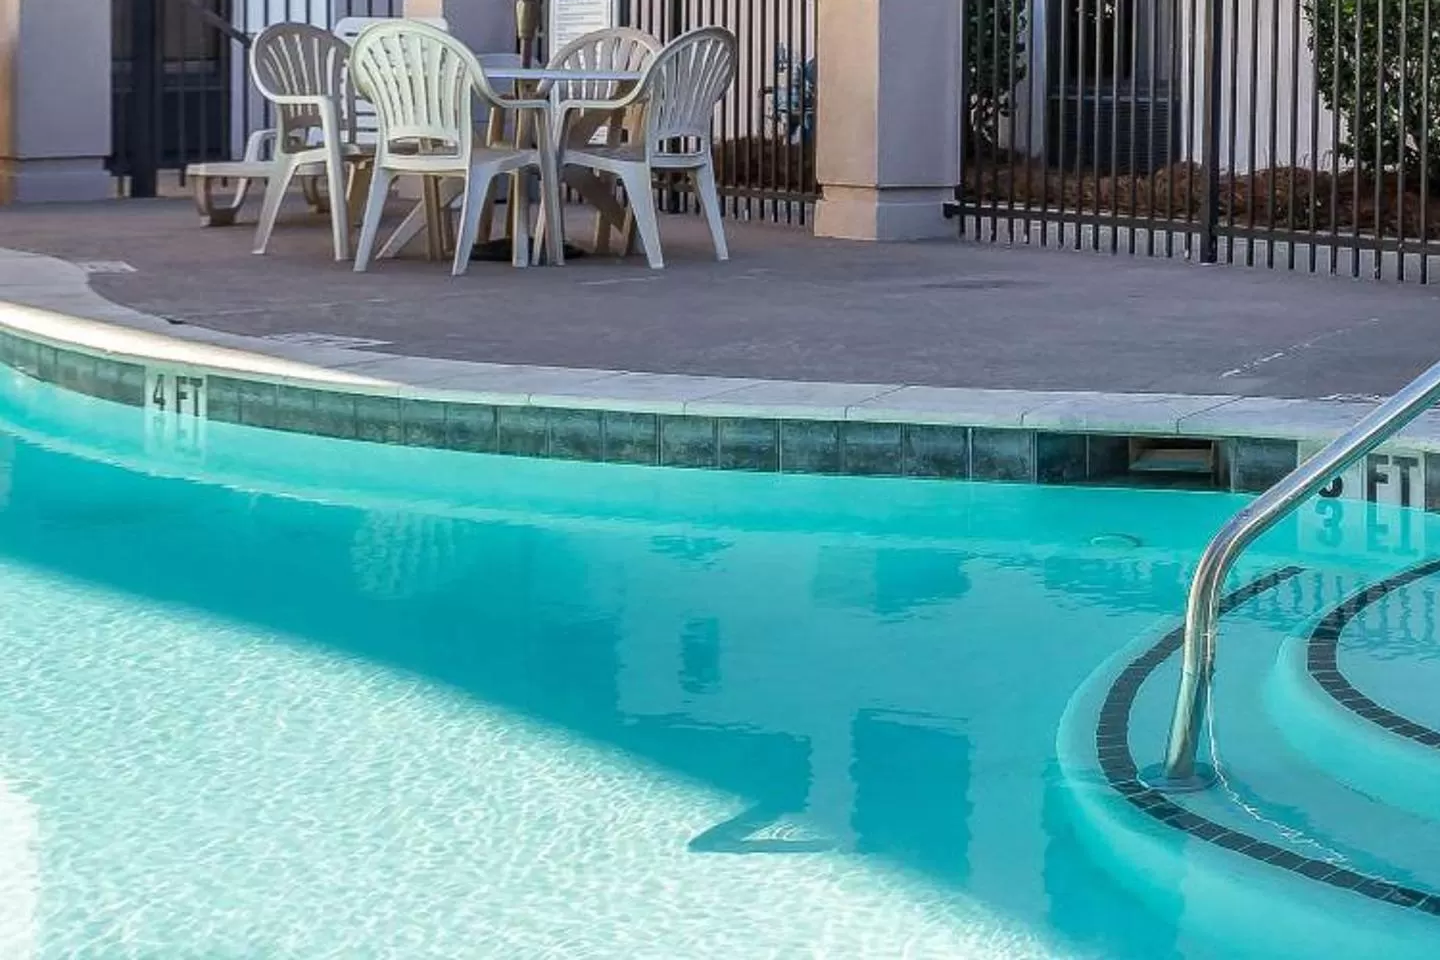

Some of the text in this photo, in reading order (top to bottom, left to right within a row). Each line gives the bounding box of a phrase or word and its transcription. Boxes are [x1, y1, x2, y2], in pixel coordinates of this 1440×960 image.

[153, 374, 203, 417] 4 FT
[1367, 453, 1418, 507] FT
